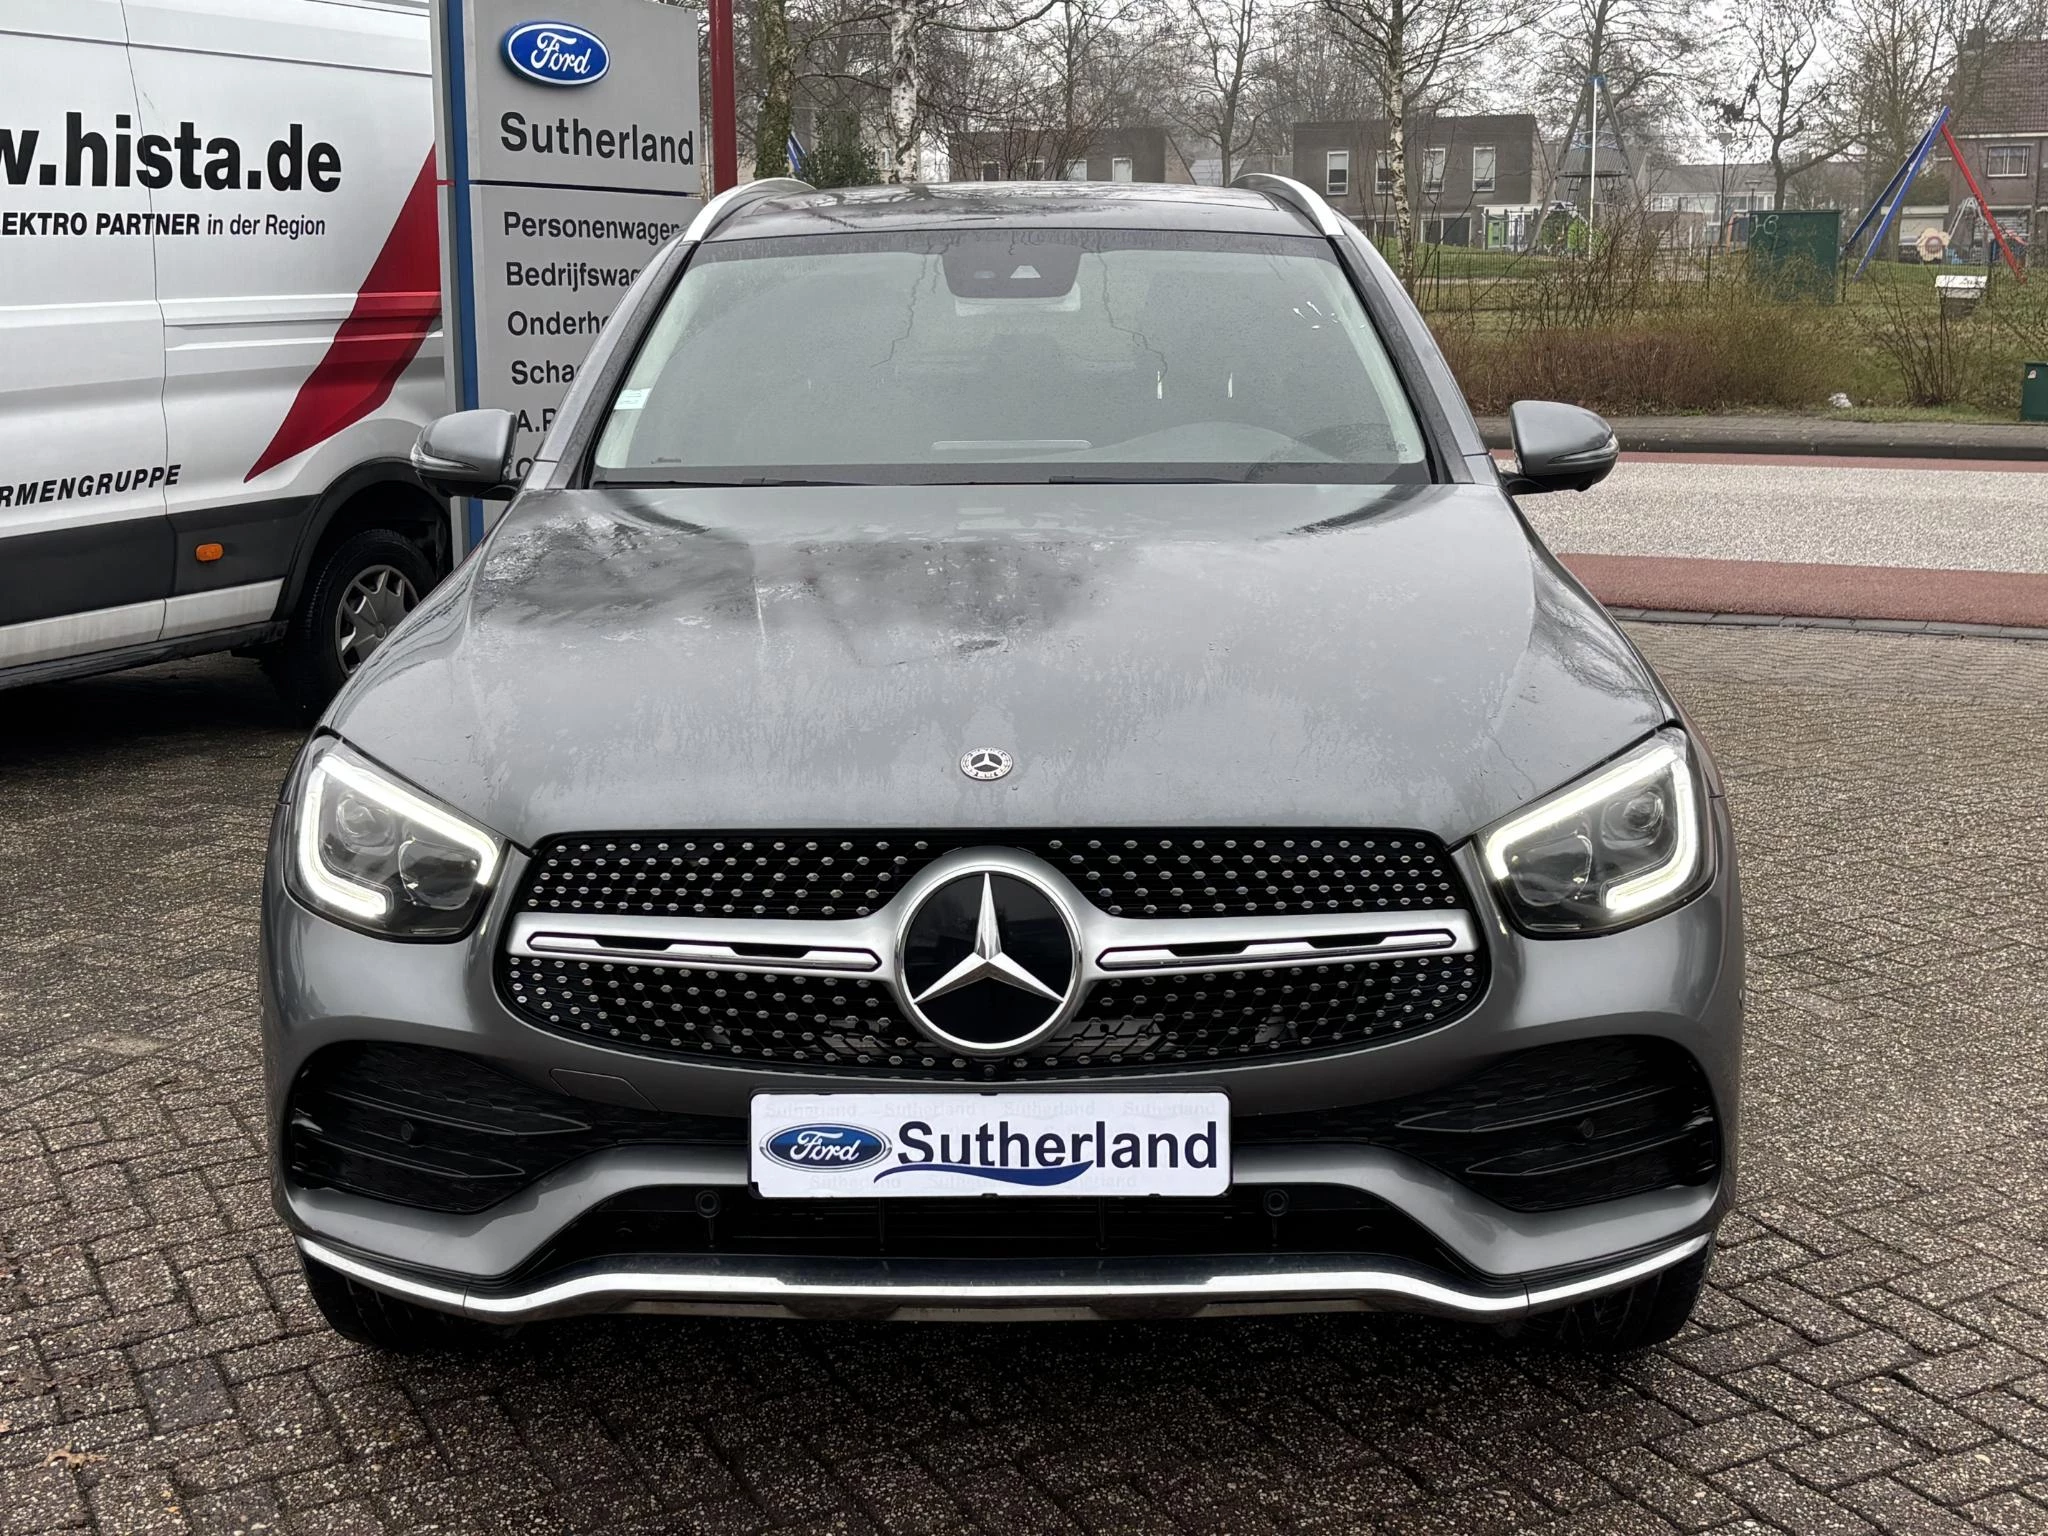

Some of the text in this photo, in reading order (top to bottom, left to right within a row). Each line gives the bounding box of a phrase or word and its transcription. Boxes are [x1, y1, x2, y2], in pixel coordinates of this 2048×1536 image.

[530, 31, 592, 75] Ford
[500, 111, 694, 166] Sutherland
[0, 212, 326, 241] EKTRO PARTNER in der Region
[511, 359, 581, 385] Scha
[0, 463, 182, 508] RMENGRUPPE
[789, 1120, 1218, 1169] Ford Sutherland
